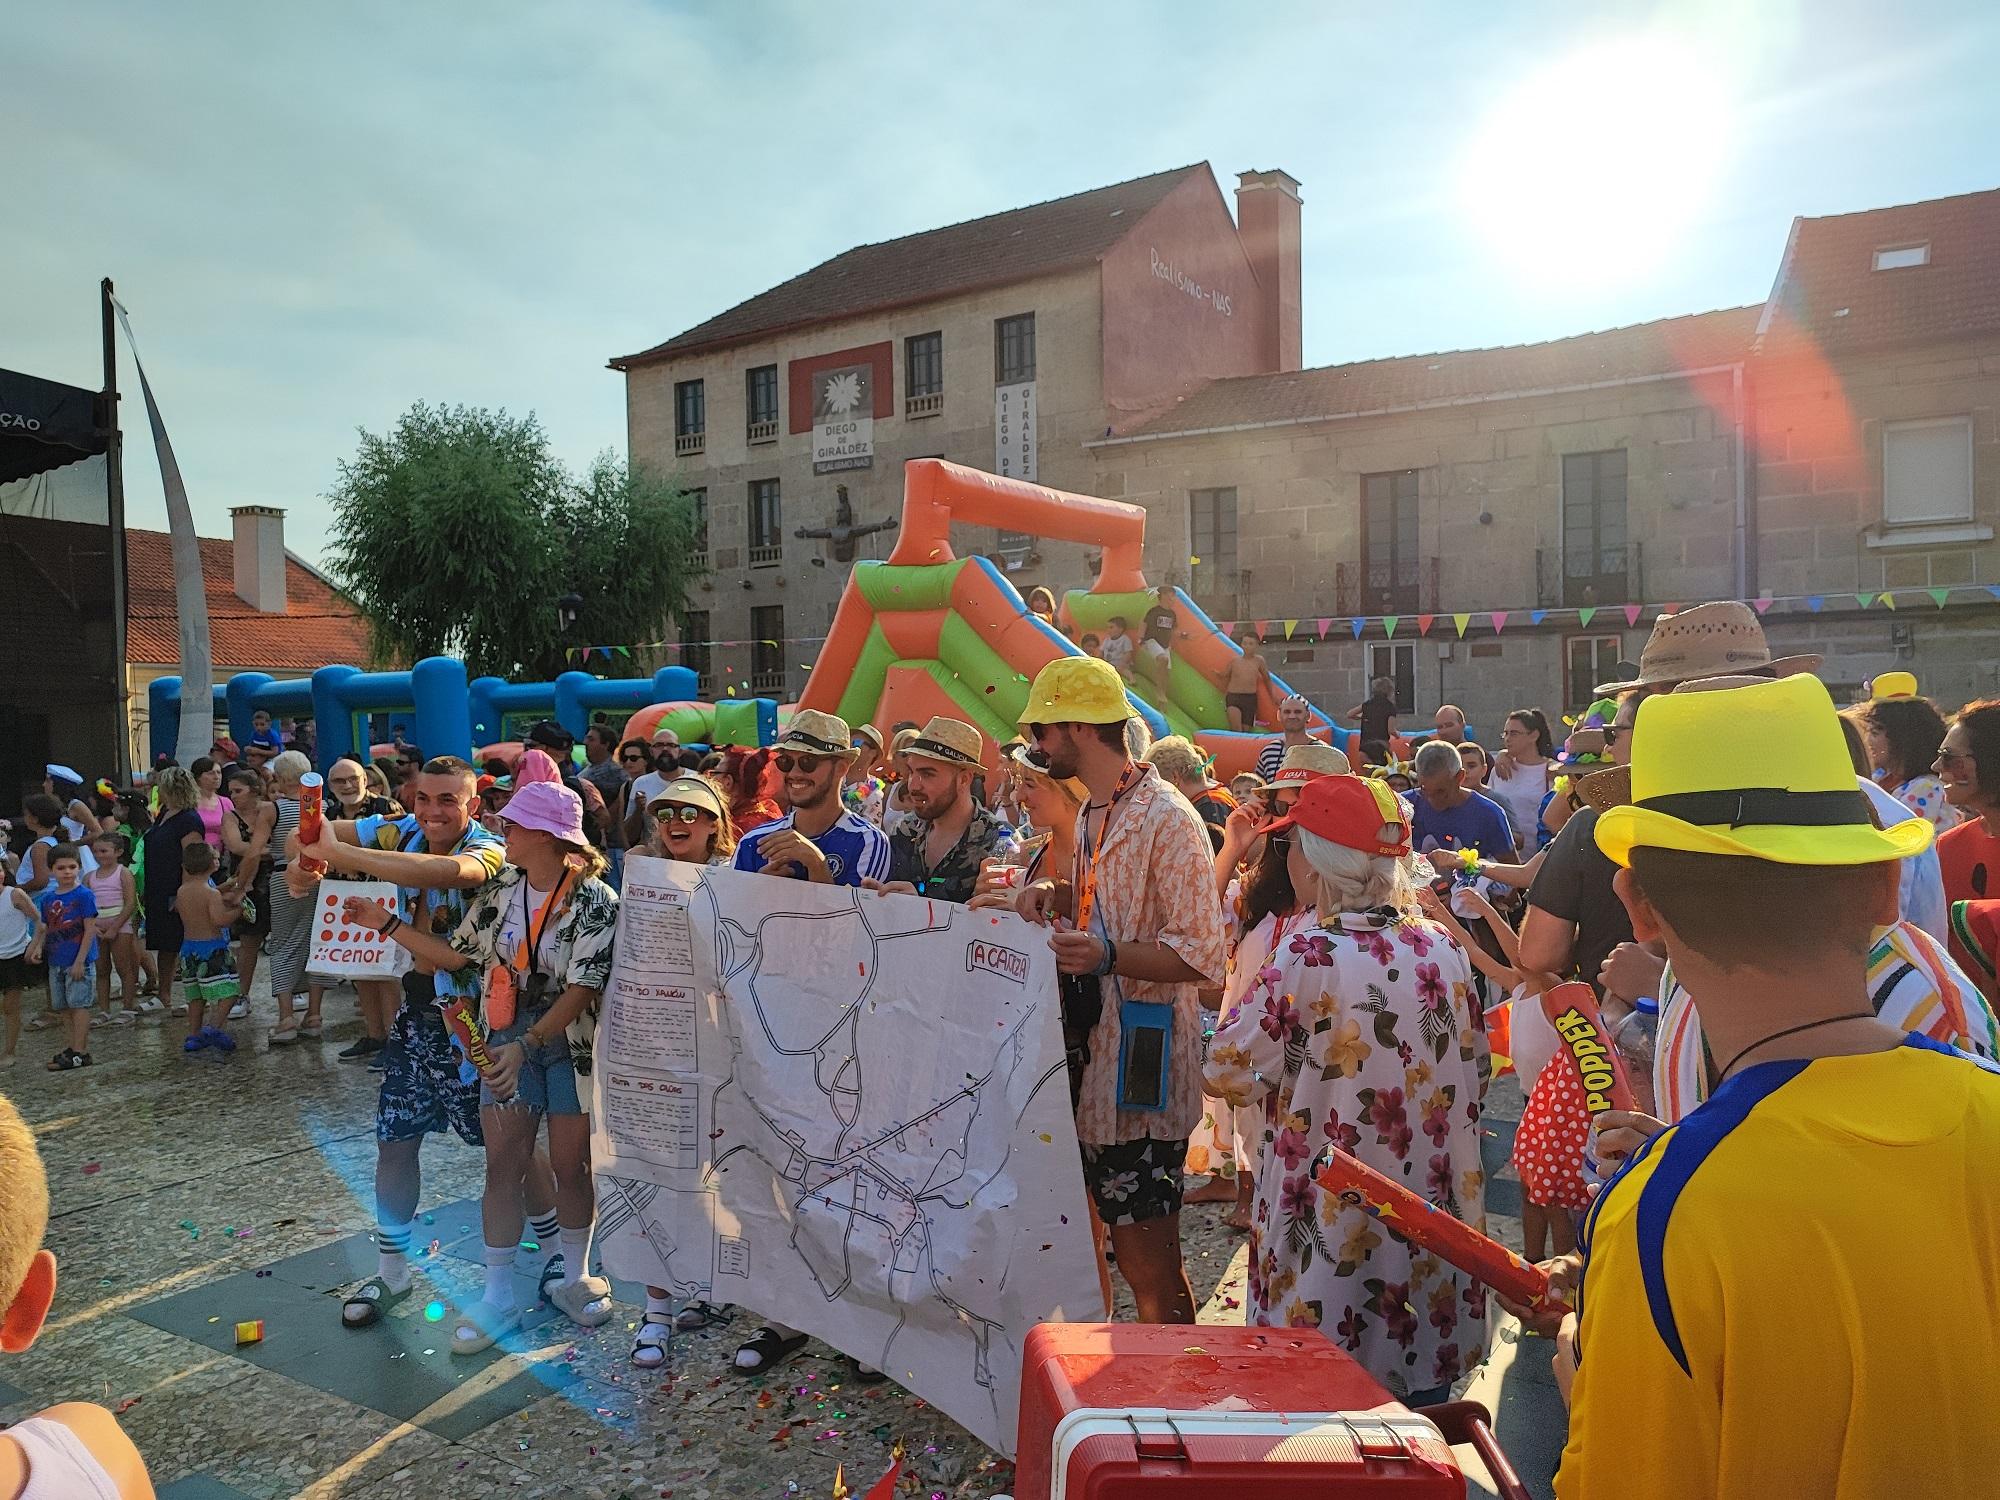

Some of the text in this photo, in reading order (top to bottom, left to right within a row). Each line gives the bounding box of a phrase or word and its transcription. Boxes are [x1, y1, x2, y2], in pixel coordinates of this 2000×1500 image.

[826, 422, 857, 436] DIEGO
[1022, 389, 1030, 475] GIRALDEZ
[838, 436, 846, 444] DE
[817, 442, 868, 458] GIRALDEZ
[1002, 458, 1009, 477] DE
[329, 948, 385, 963] cenor
[974, 944, 985, 964] A
[1555, 1008, 1614, 1112] POPPER
